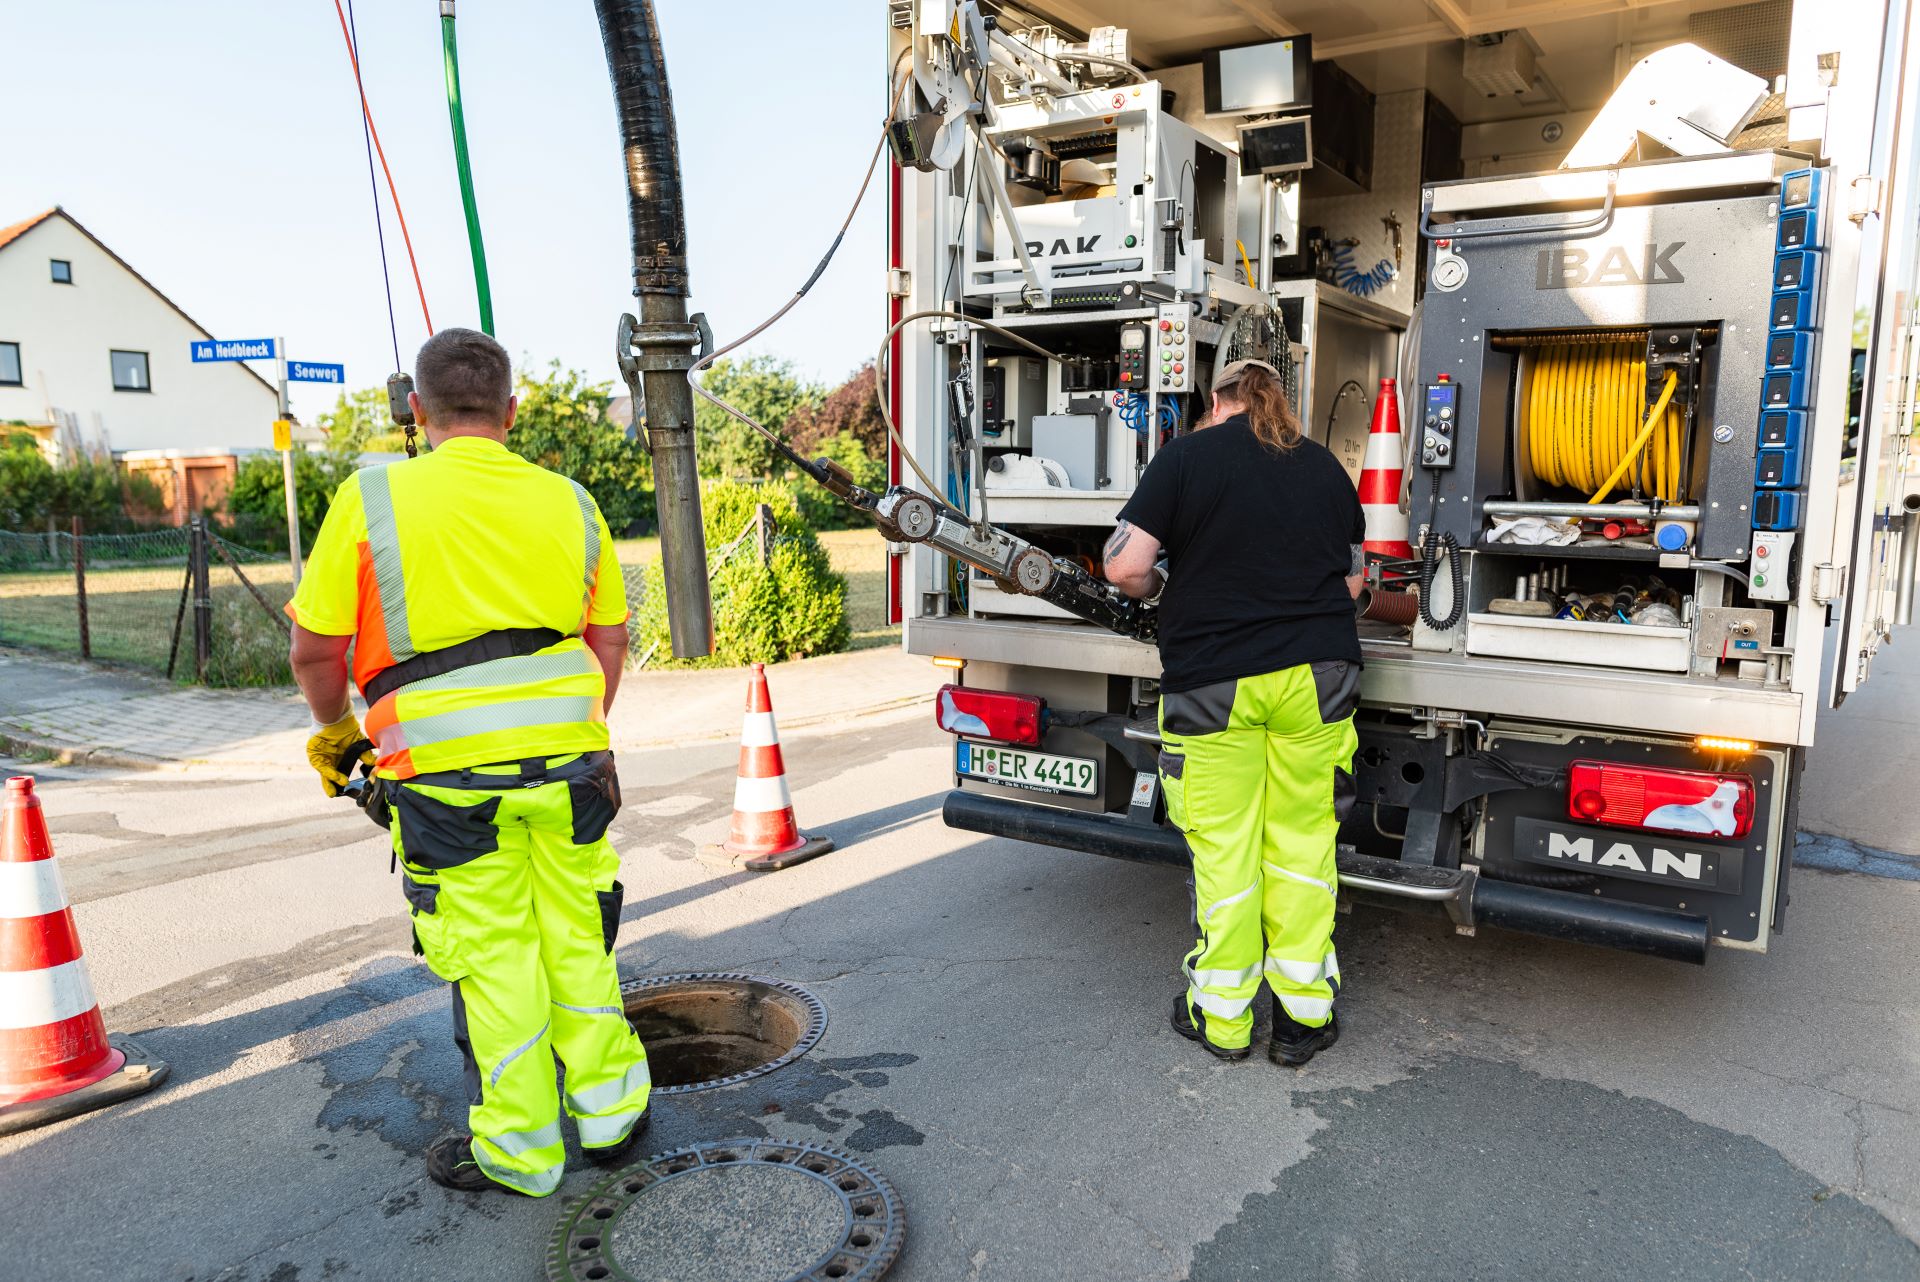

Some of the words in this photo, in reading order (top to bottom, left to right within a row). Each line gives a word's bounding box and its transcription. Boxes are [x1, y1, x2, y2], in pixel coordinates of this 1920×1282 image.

[1536, 241, 1687, 290] IBAK
[197, 345, 213, 359] Am
[216, 341, 269, 358] Heidbleeck
[294, 363, 339, 382] Seeweg
[970, 747, 985, 772] H
[999, 751, 1028, 780] ER
[1034, 758, 1093, 789] 4419
[1548, 832, 1702, 880] MAN
